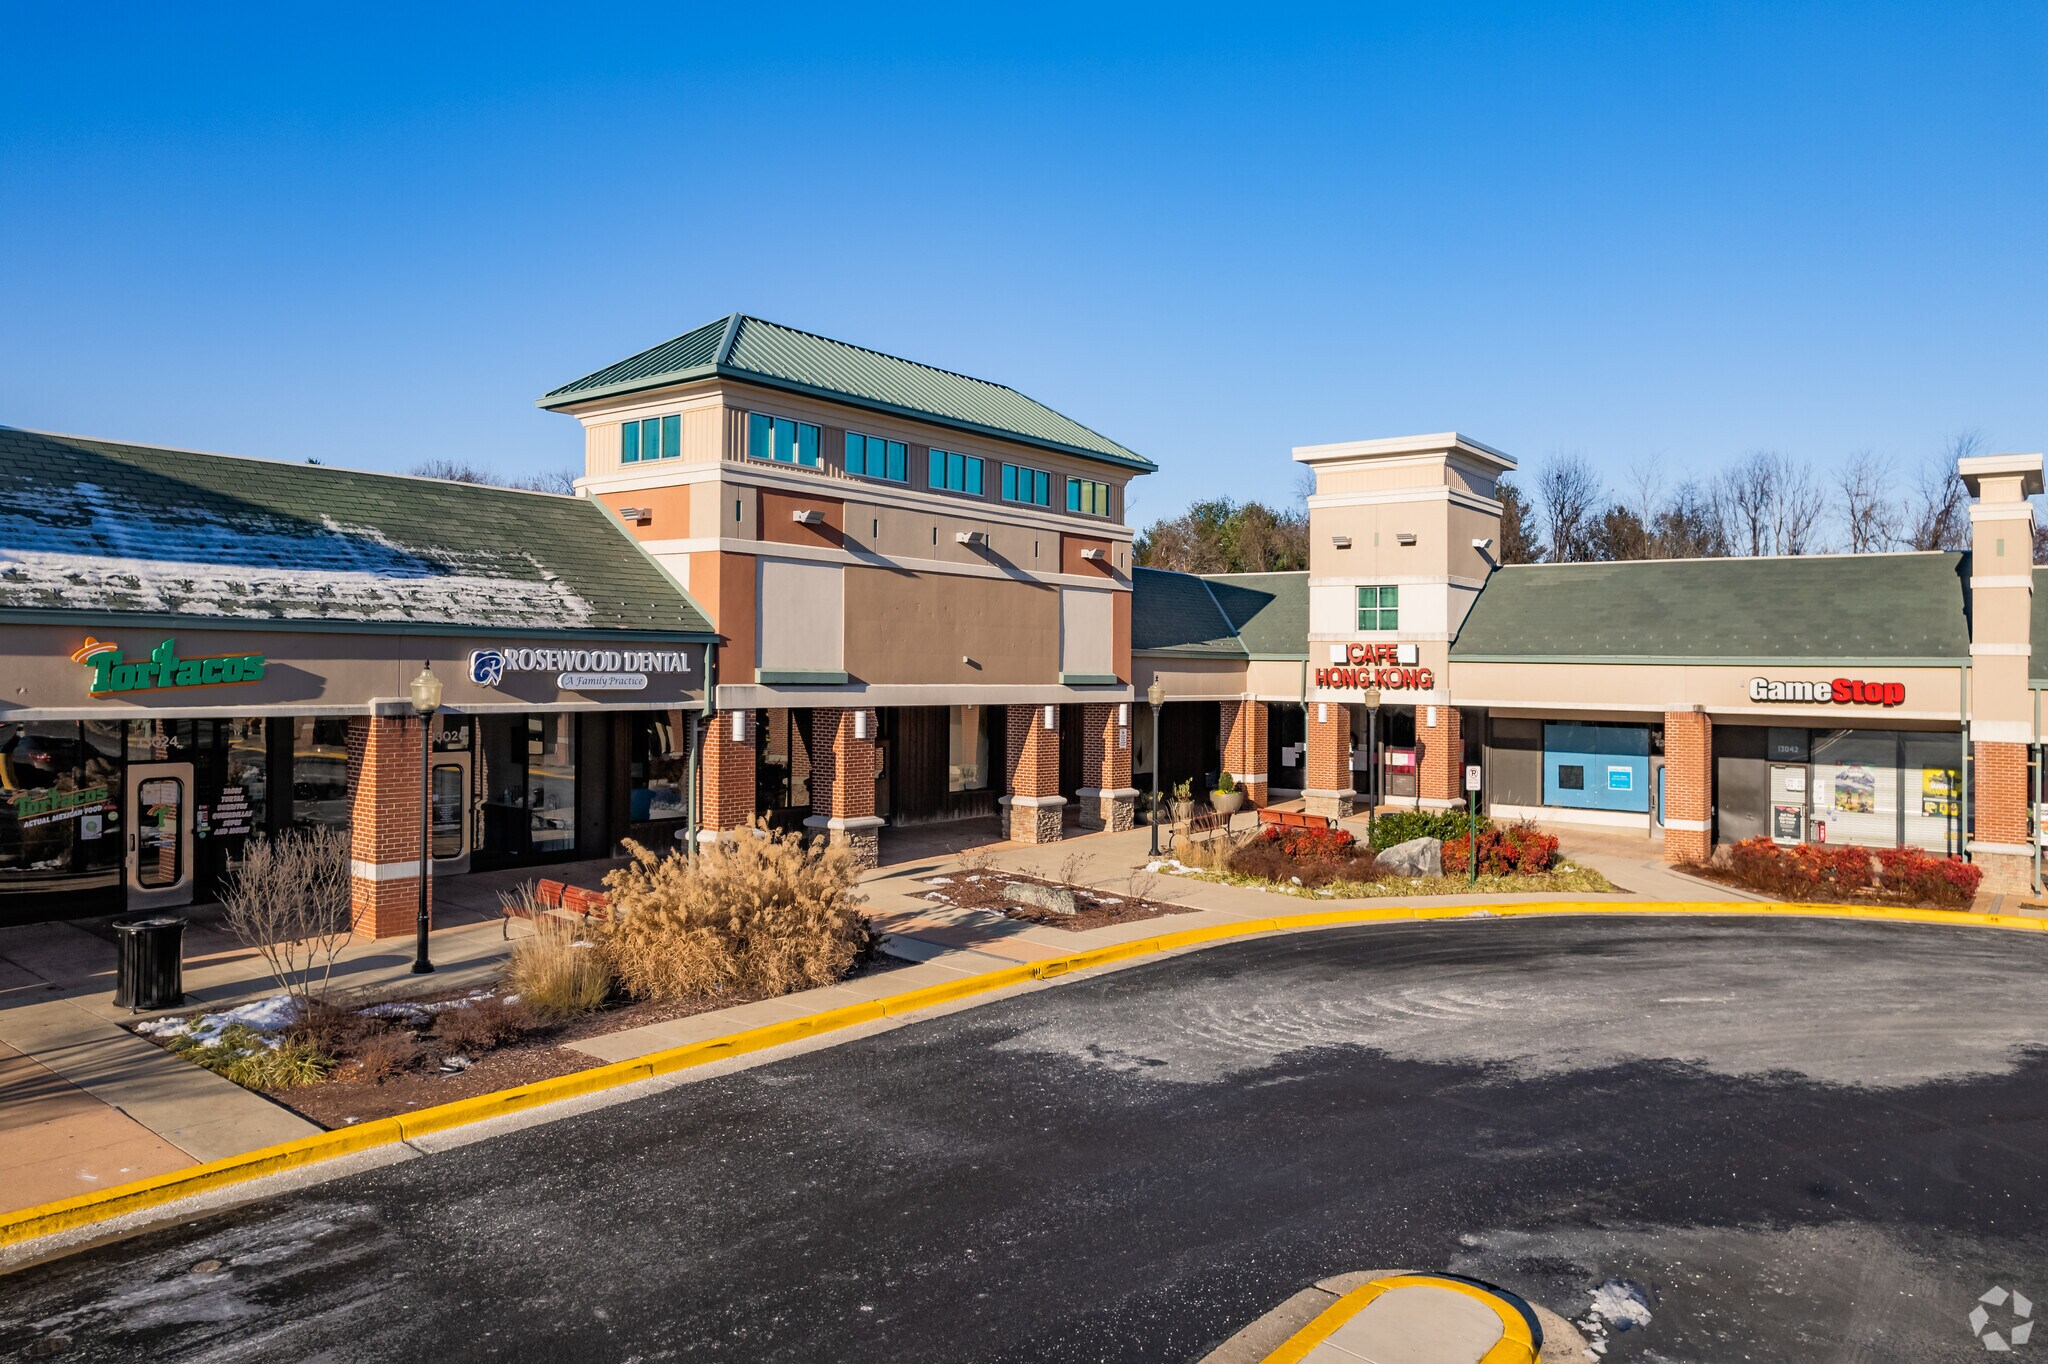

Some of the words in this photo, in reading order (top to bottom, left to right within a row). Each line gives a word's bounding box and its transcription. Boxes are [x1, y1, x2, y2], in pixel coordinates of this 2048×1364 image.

[504, 648, 621, 672] ROSEWOOD
[624, 651, 691, 672] DENTAL
[1347, 643, 1398, 663] CAFE
[565, 677, 574, 686] A
[575, 676, 607, 689] Family
[608, 676, 643, 686] Practice
[1315, 667, 1371, 688] HONG
[1374, 667, 1434, 689] KONG
[1749, 677, 1905, 705] GameStop
[1777, 745, 1799, 753] 13042
[23, 816, 51, 829] ACTUAL
[51, 809, 83, 823] MEXICAN
[84, 804, 103, 815] FOOD
